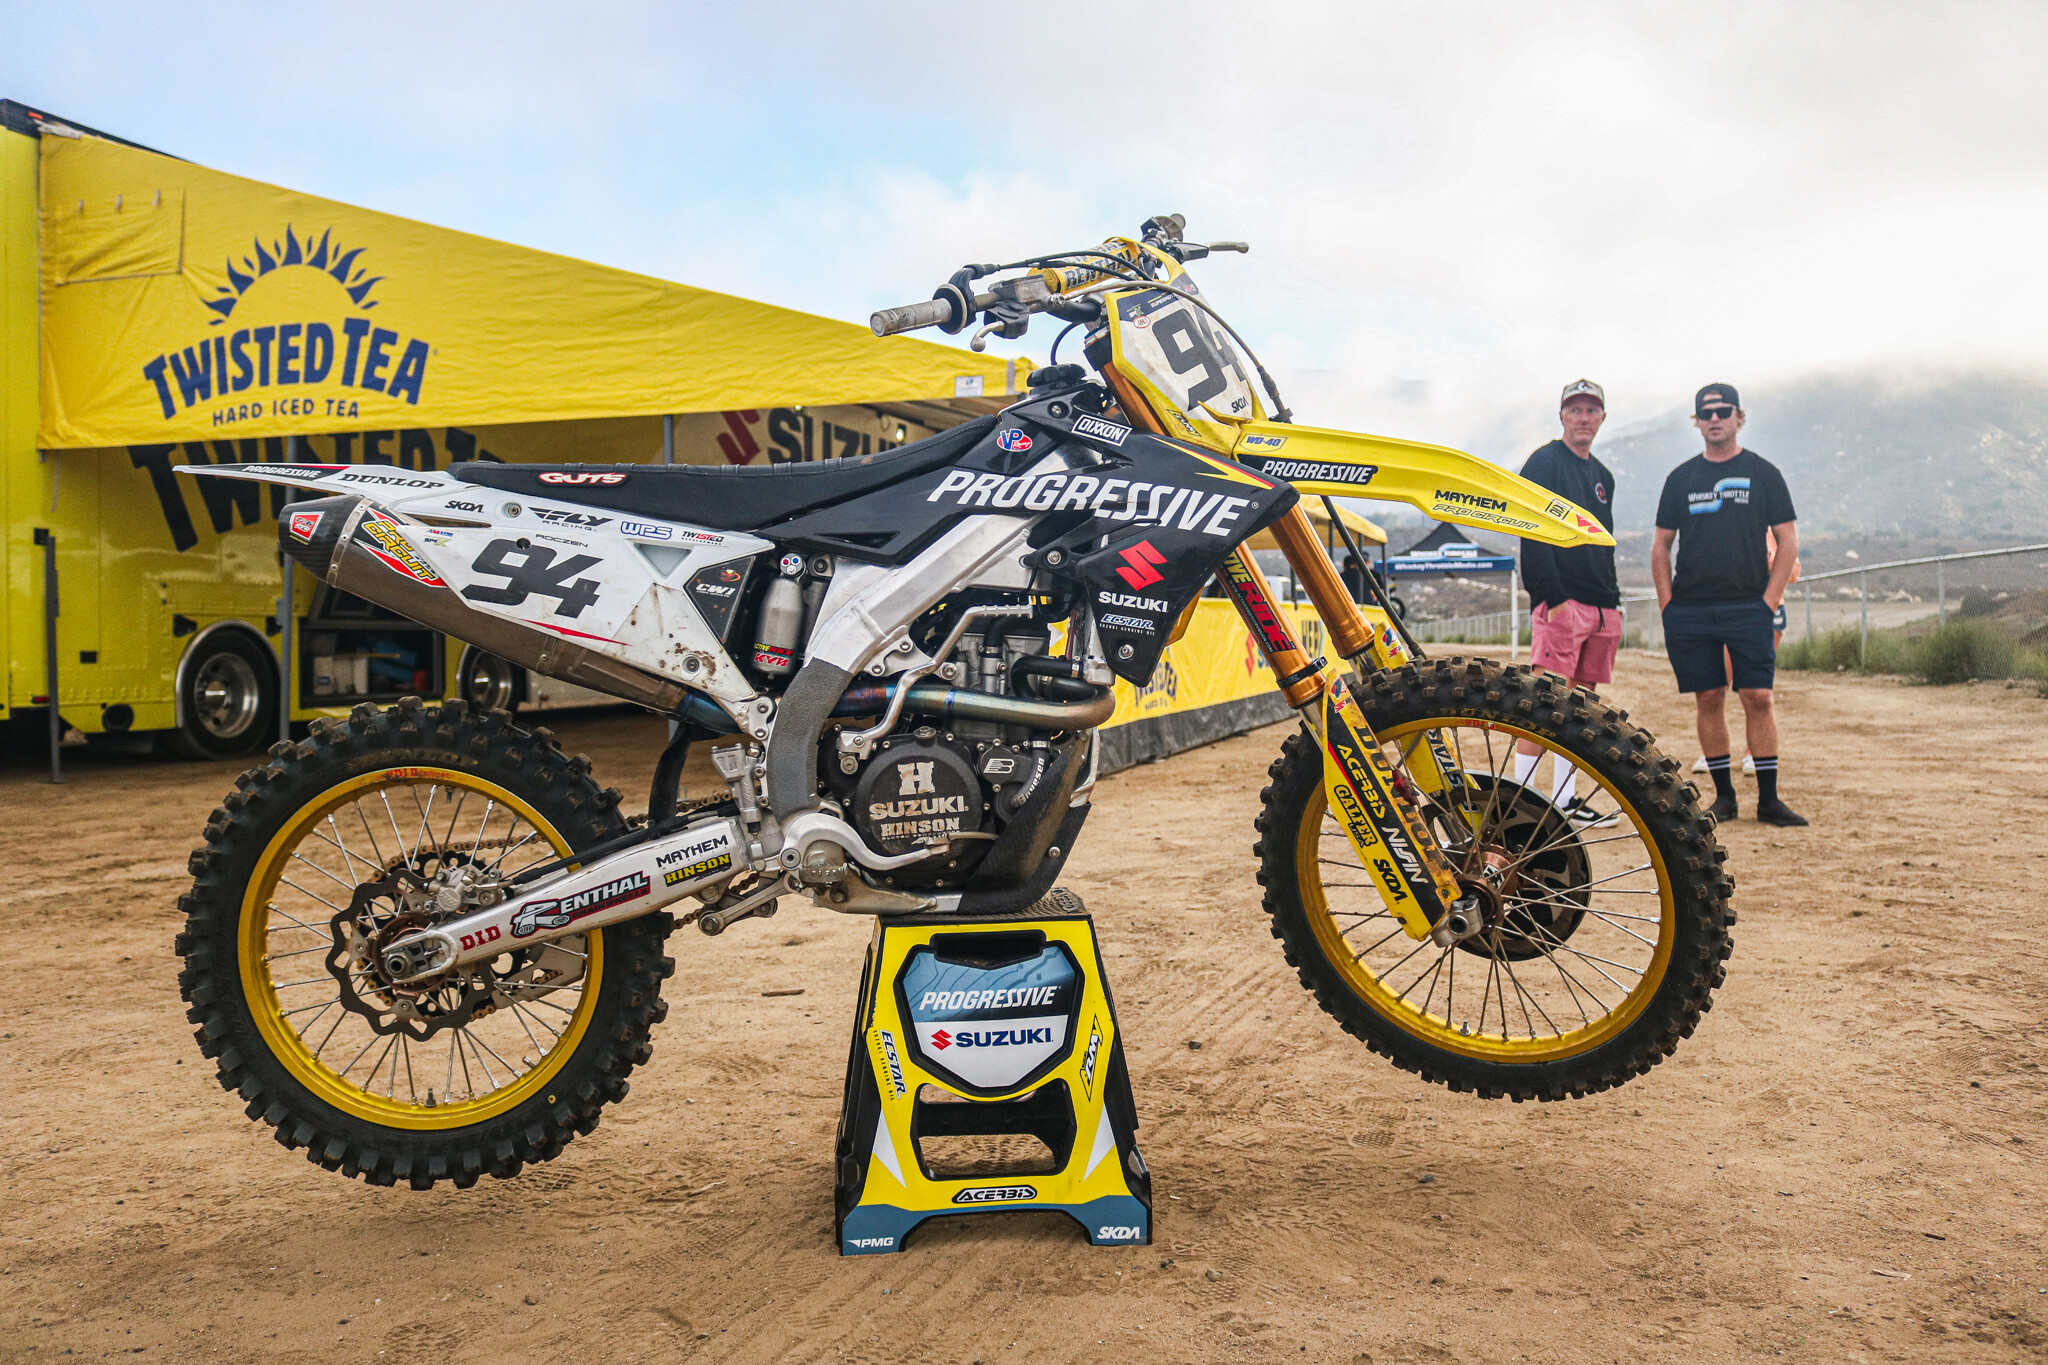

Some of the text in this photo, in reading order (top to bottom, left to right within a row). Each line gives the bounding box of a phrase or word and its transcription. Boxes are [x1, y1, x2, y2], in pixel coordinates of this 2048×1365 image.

[142, 317, 429, 420] TWISTED TEA
[1152, 304, 1246, 411] 94
[213, 399, 358, 426] HARD ICED TEA
[1078, 417, 1124, 441] DIXXON
[1245, 435, 1281, 448] WD-40
[242, 465, 321, 479] PROGRESSIVE
[338, 473, 445, 489] DUNLOP
[539, 473, 626, 484] GUTS
[1262, 459, 1373, 484] PROGRESSIVE
[445, 501, 483, 513] SKDA
[926, 470, 1250, 537] PROGRESSIVE
[1435, 490, 1507, 512] MAYHEM
[528, 506, 614, 526] FLY
[542, 520, 596, 531] RACING
[1433, 504, 1472, 517] PRO
[1471, 510, 1539, 530] CIRCUIT
[535, 533, 589, 548] ROCZEN
[621, 521, 672, 540] WPS
[682, 531, 724, 543] TWISTED
[363, 522, 436, 579] CIRCUIT
[460, 538, 604, 619] 94
[1098, 591, 1169, 613] SUZUKI
[1101, 613, 1155, 631] ECSTAR
[754, 653, 789, 667] KYB
[868, 795, 965, 820] SUZUKI
[1335, 786, 1378, 847] GALFER
[881, 817, 960, 837] HINSON
[656, 835, 728, 868] MAYHEM
[1382, 827, 1429, 884] NISSIN
[665, 854, 731, 884] HINSON
[1373, 858, 1408, 903] SKDA
[918, 986, 1057, 1011] PROGRESSIVE
[955, 1028, 1052, 1048] SUZUKI
[880, 1029, 907, 1100] ECSTAR
[955, 1187, 1033, 1202] ACERBIS
[861, 1237, 894, 1247] PMG
[1097, 1226, 1140, 1240] SKDA
